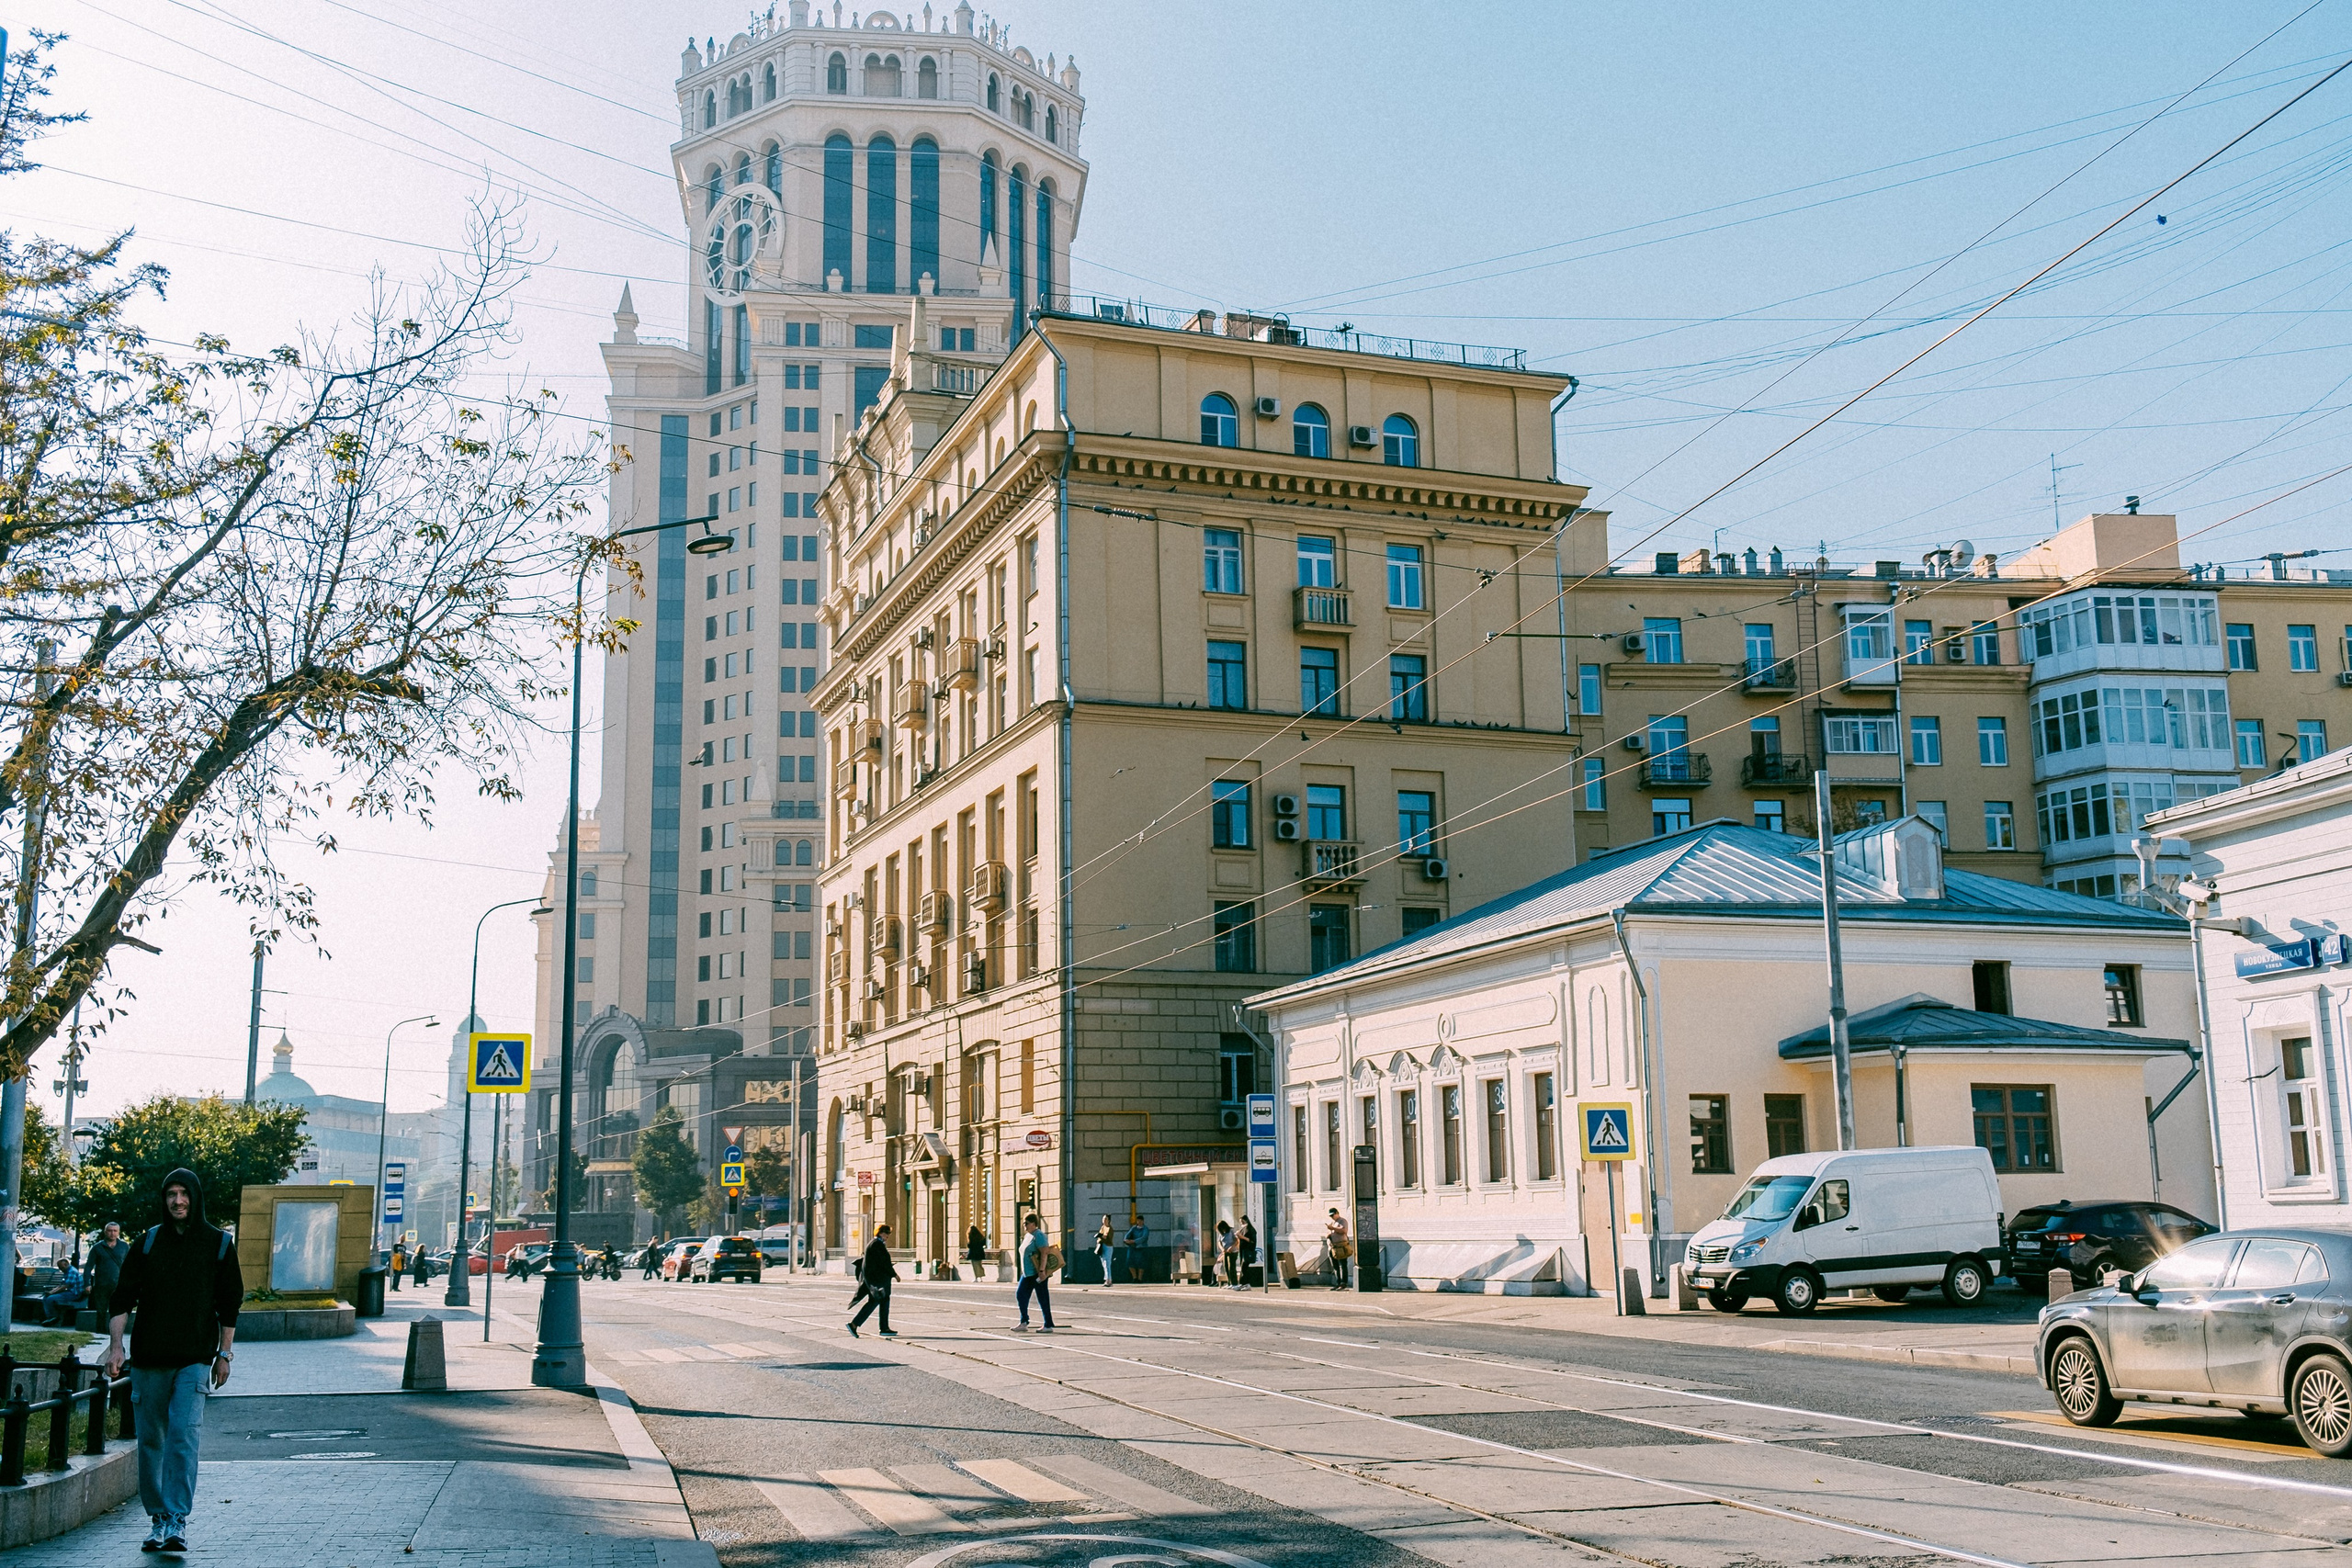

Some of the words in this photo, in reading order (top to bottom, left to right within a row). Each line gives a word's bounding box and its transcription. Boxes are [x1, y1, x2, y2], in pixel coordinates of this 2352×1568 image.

[2243, 948, 2302, 966] НОВОКУЗНЕЦКАЯ
[2324, 941, 2339, 955] 42
[1142, 1147, 1221, 1166] ЦВЕТОЧНЫЙ
[1225, 1149, 1248, 1164] СКЛ
